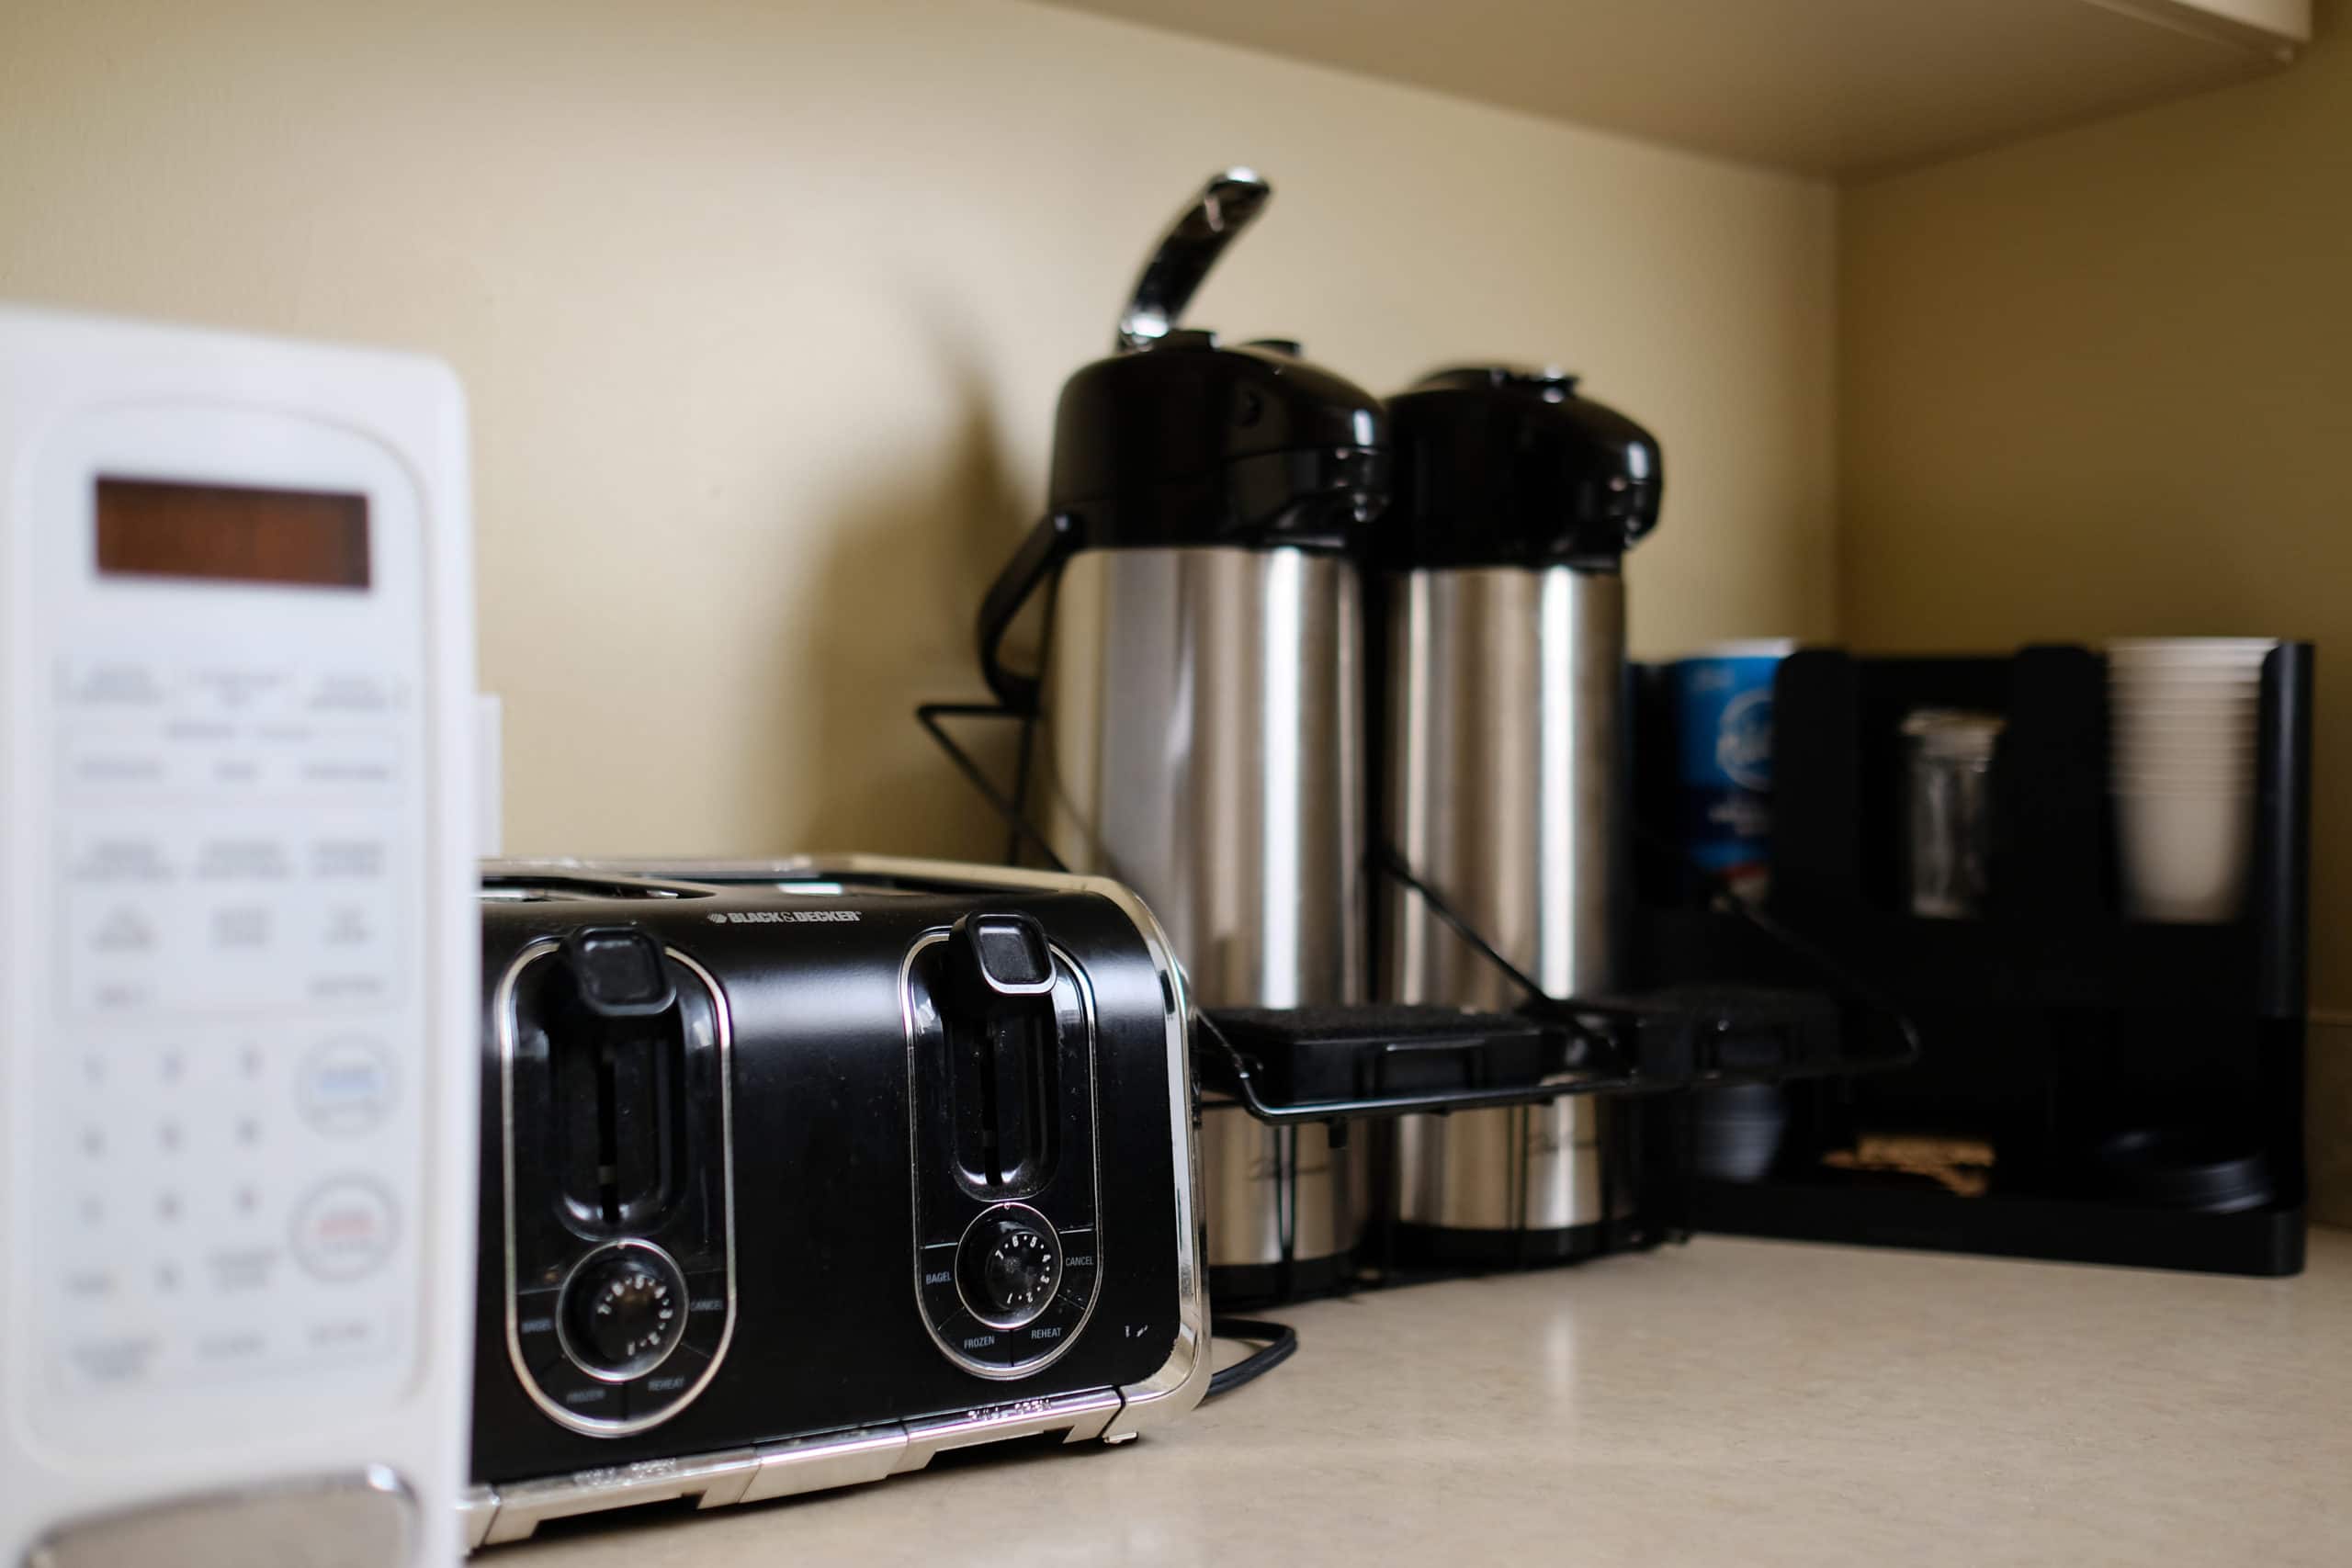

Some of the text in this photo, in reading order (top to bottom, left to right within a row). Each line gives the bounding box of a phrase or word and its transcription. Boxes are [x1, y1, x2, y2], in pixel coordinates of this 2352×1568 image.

[726, 910, 860, 923] BLACK&DECKER
[1065, 1256, 1094, 1267] CANCEL
[925, 1271, 951, 1285] BAGEL
[1031, 1326, 1062, 1339] REHEAT
[964, 1335, 995, 1349] FROZEN
